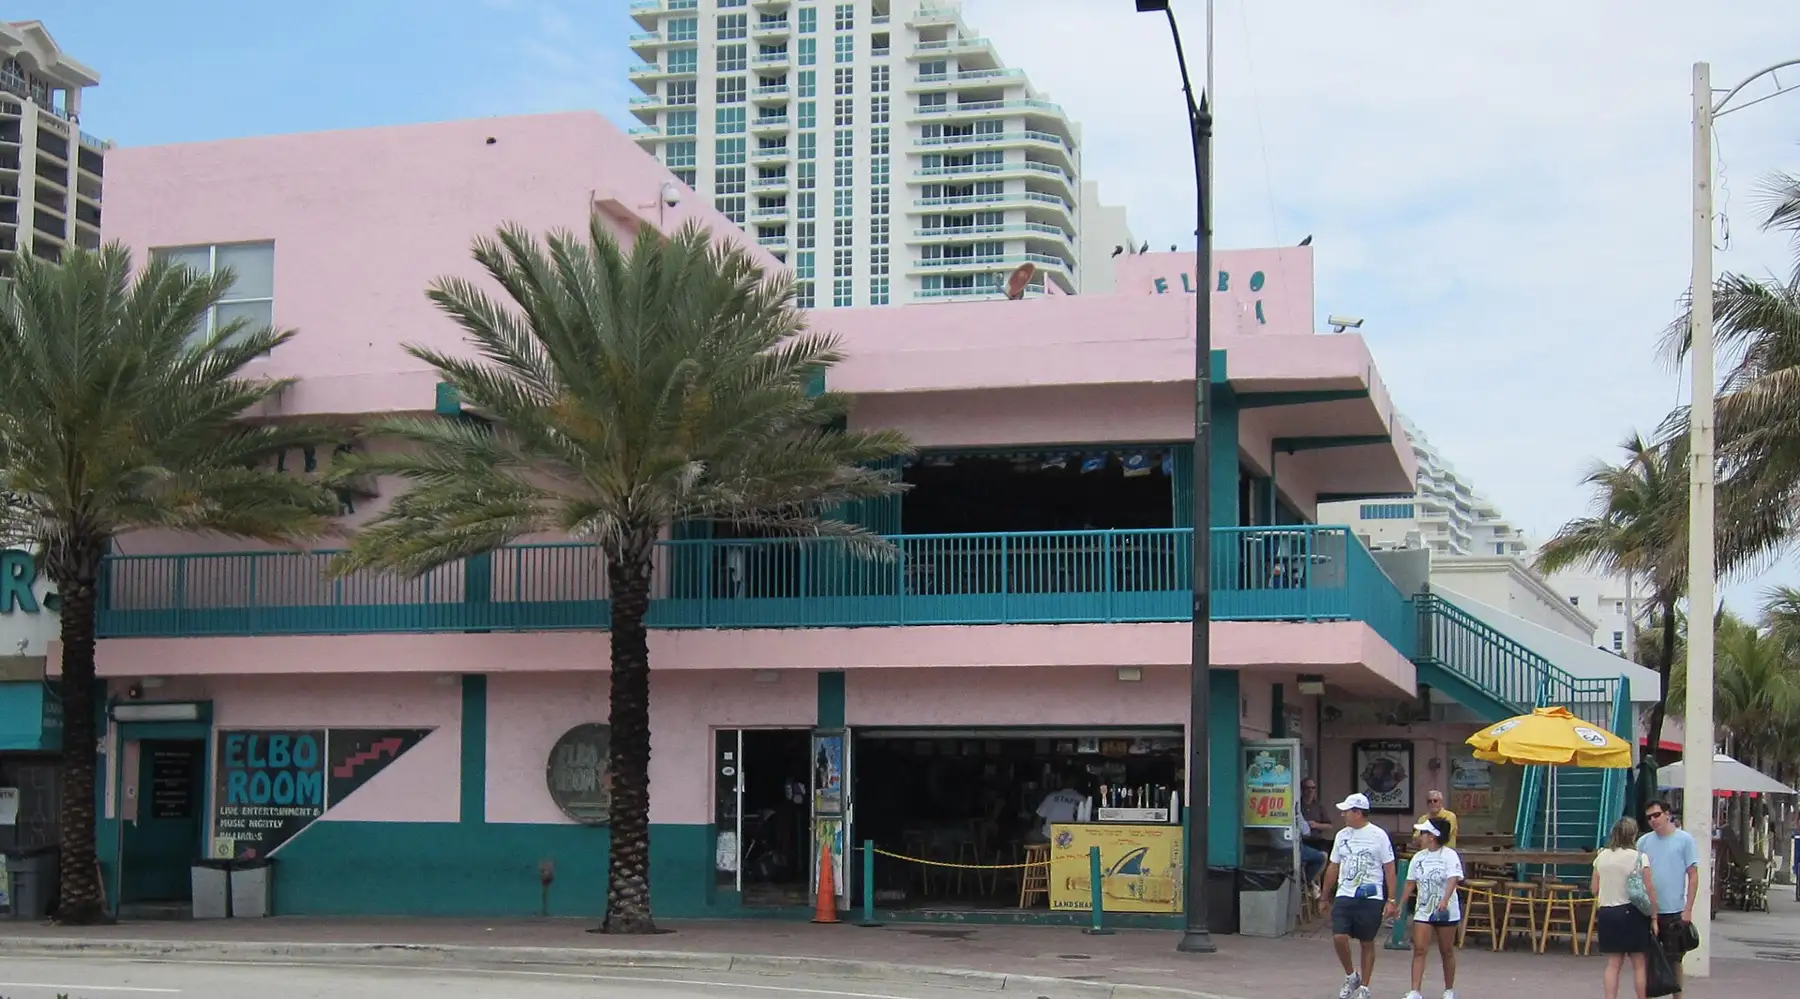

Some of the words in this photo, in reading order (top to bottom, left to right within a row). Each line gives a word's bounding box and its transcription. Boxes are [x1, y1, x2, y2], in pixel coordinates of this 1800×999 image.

[226, 735, 317, 768] ELBO
[228, 770, 322, 805] ROOM
[220, 807, 239, 815] LIVE
[220, 819, 246, 828] MUSIC
